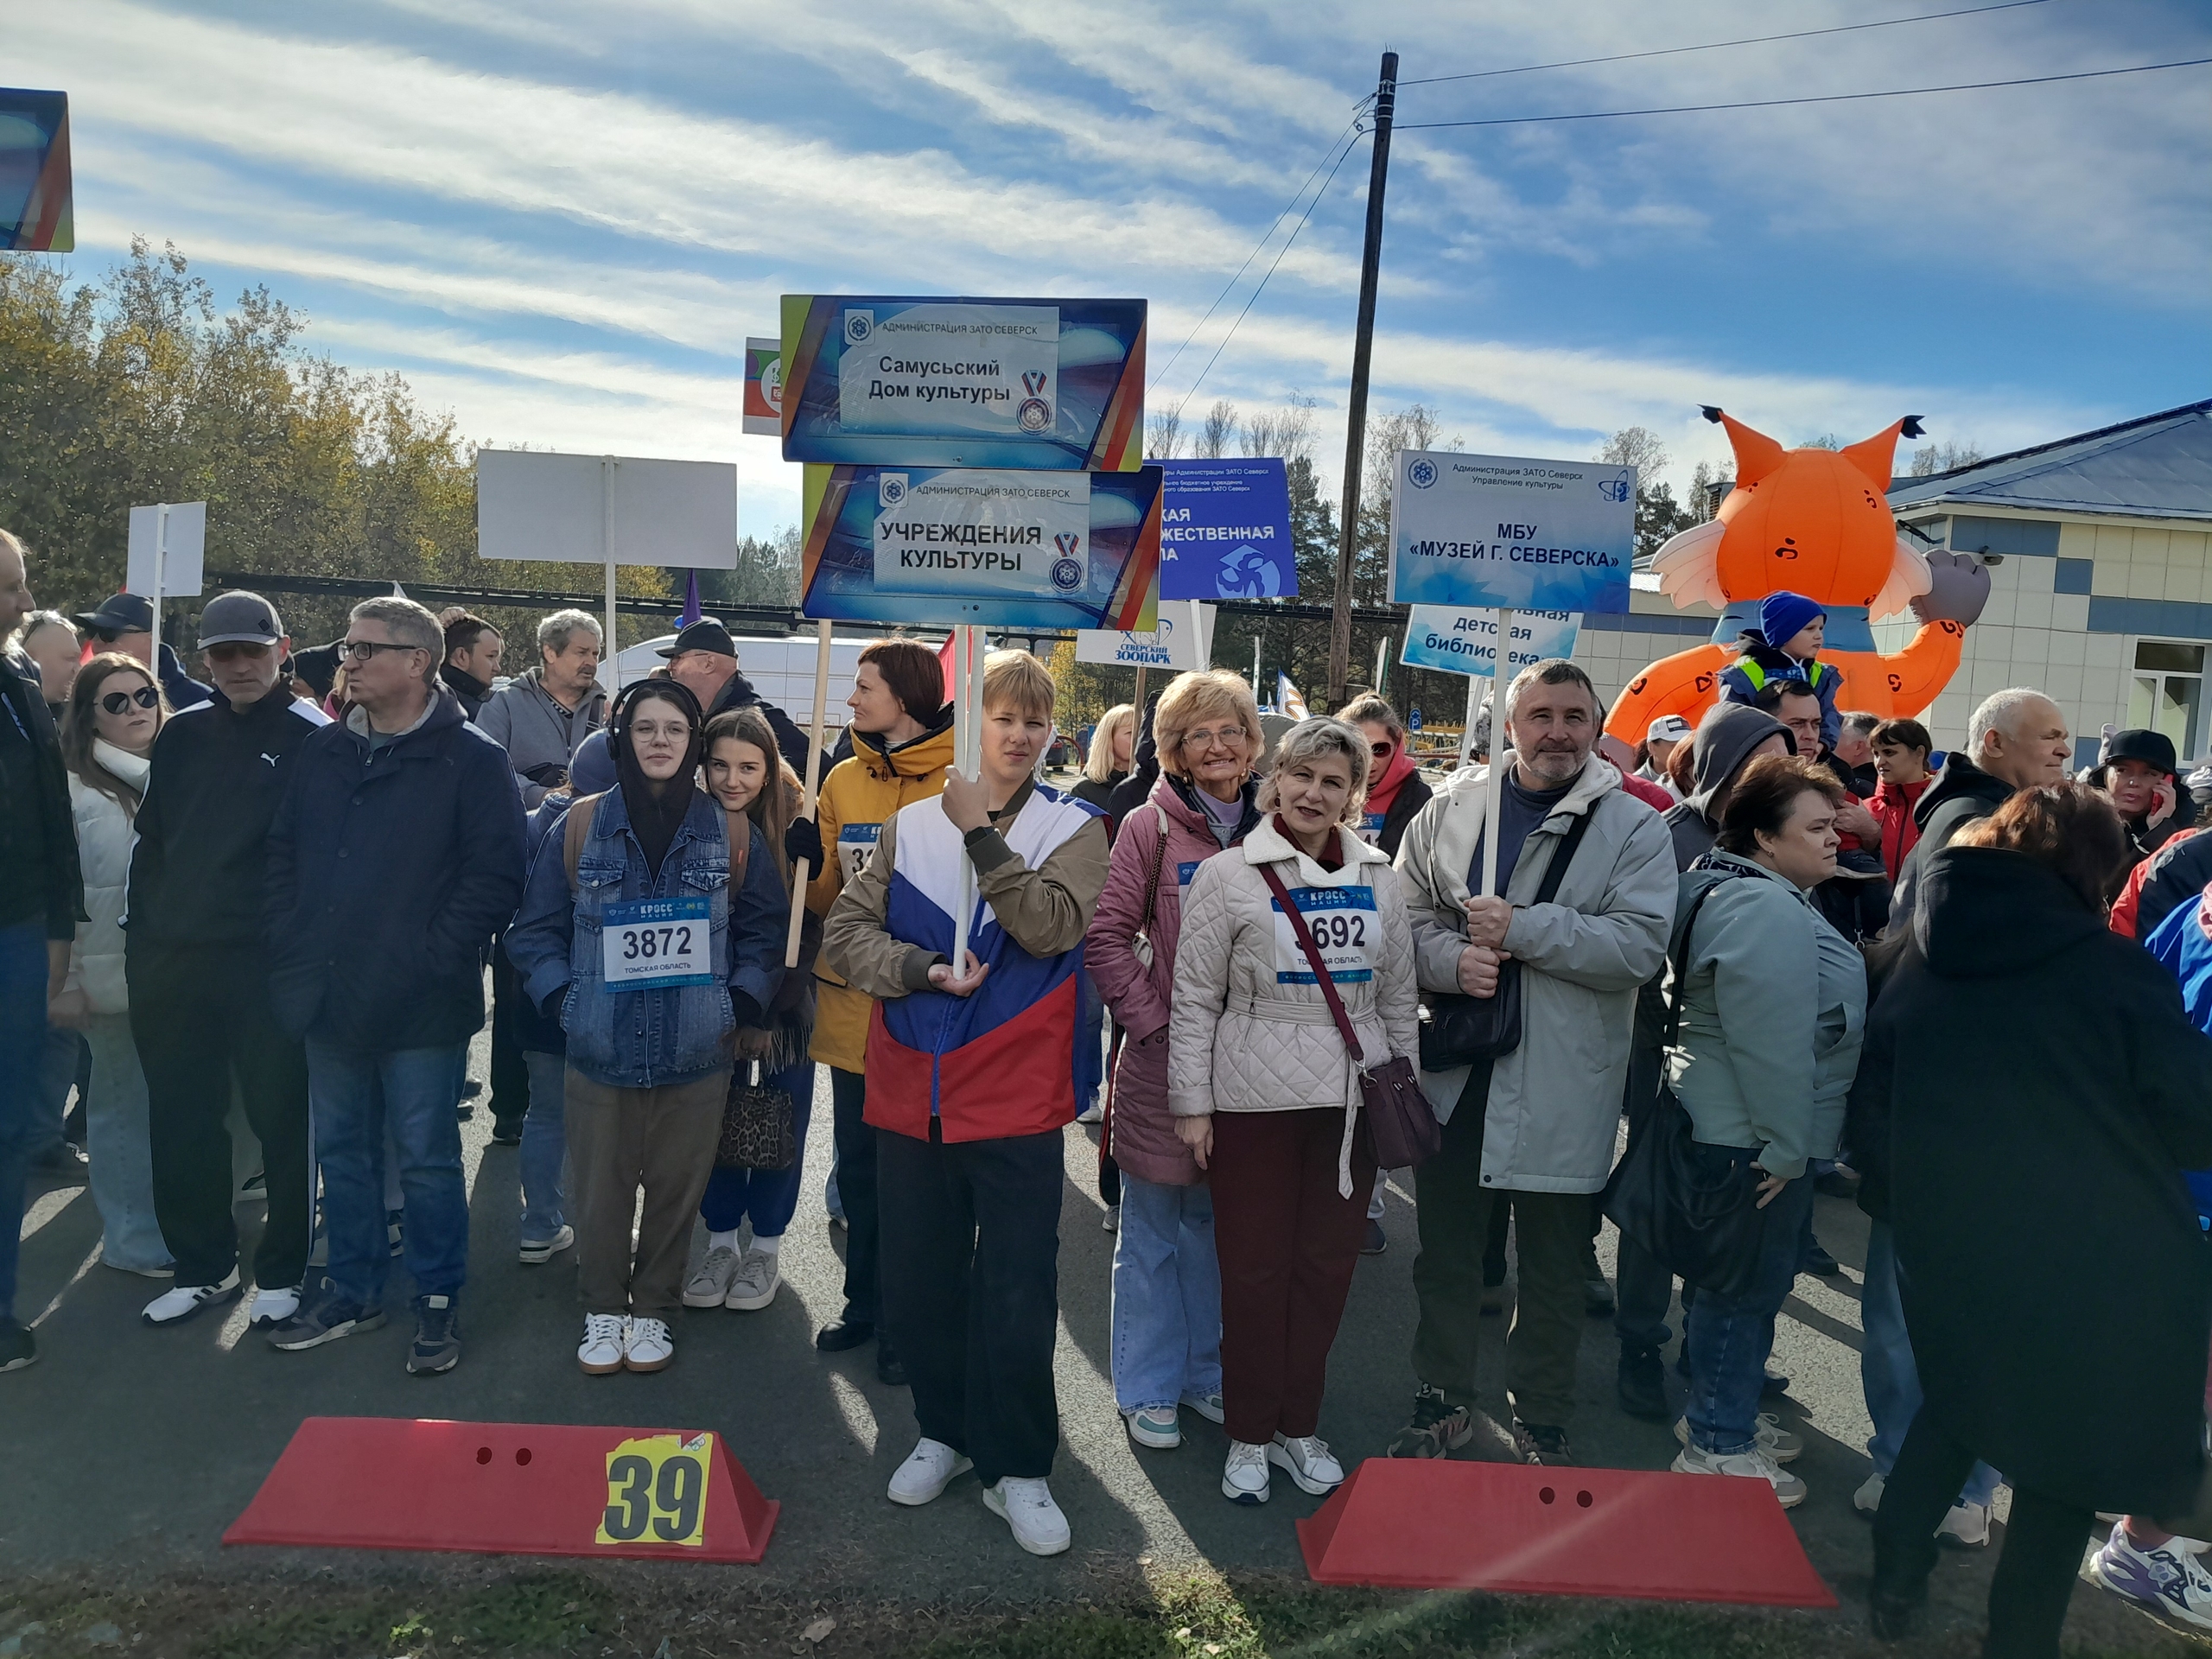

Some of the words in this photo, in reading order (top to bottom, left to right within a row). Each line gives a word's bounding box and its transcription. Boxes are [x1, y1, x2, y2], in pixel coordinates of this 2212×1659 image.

[882, 322, 967, 334] АДМИНИСТРАЦИЯ
[969, 325, 993, 334] ЗАТО
[995, 325, 1038, 335] СЕВЕРСК
[879, 355, 1000, 378] Самусьский
[868, 380, 909, 399] Дом
[916, 385, 1010, 404] культуры
[1452, 463, 1521, 476] Администрация
[1522, 467, 1546, 478] ЗАТО
[1548, 469, 1583, 480] Северск
[916, 486, 1001, 498] АДМИНИСТРАЦИЯ
[1002, 488, 1026, 498] ЗАТО
[1027, 489, 1071, 499] СЕВЕРСК
[1471, 475, 1523, 488] Управление
[1525, 480, 1563, 490] культуры
[880, 521, 1041, 545] УЧРЕЖДЕНИЯ
[1497, 523, 1537, 540] МБУ
[900, 549, 1021, 572] КУЛЬТУРЫ
[1409, 539, 1484, 560] «МУЗЕЙ
[1491, 545, 1503, 560] Г.
[1510, 546, 1619, 568] СЕВЕРСКА»
[1453, 617, 1532, 640] детсая
[1115, 651, 1171, 664] ЗООПАРК
[1121, 644, 1167, 654] СЕВЕРСКИЙ
[1426, 633, 1545, 666] библиоека
[1311, 891, 1345, 901] КРОСС
[640, 904, 672, 914] КРОСС
[623, 926, 691, 959] 3872
[1294, 915, 1365, 950] 692
[625, 965, 658, 974] ТОМСКАЯ
[605, 1455, 702, 1541] 39
